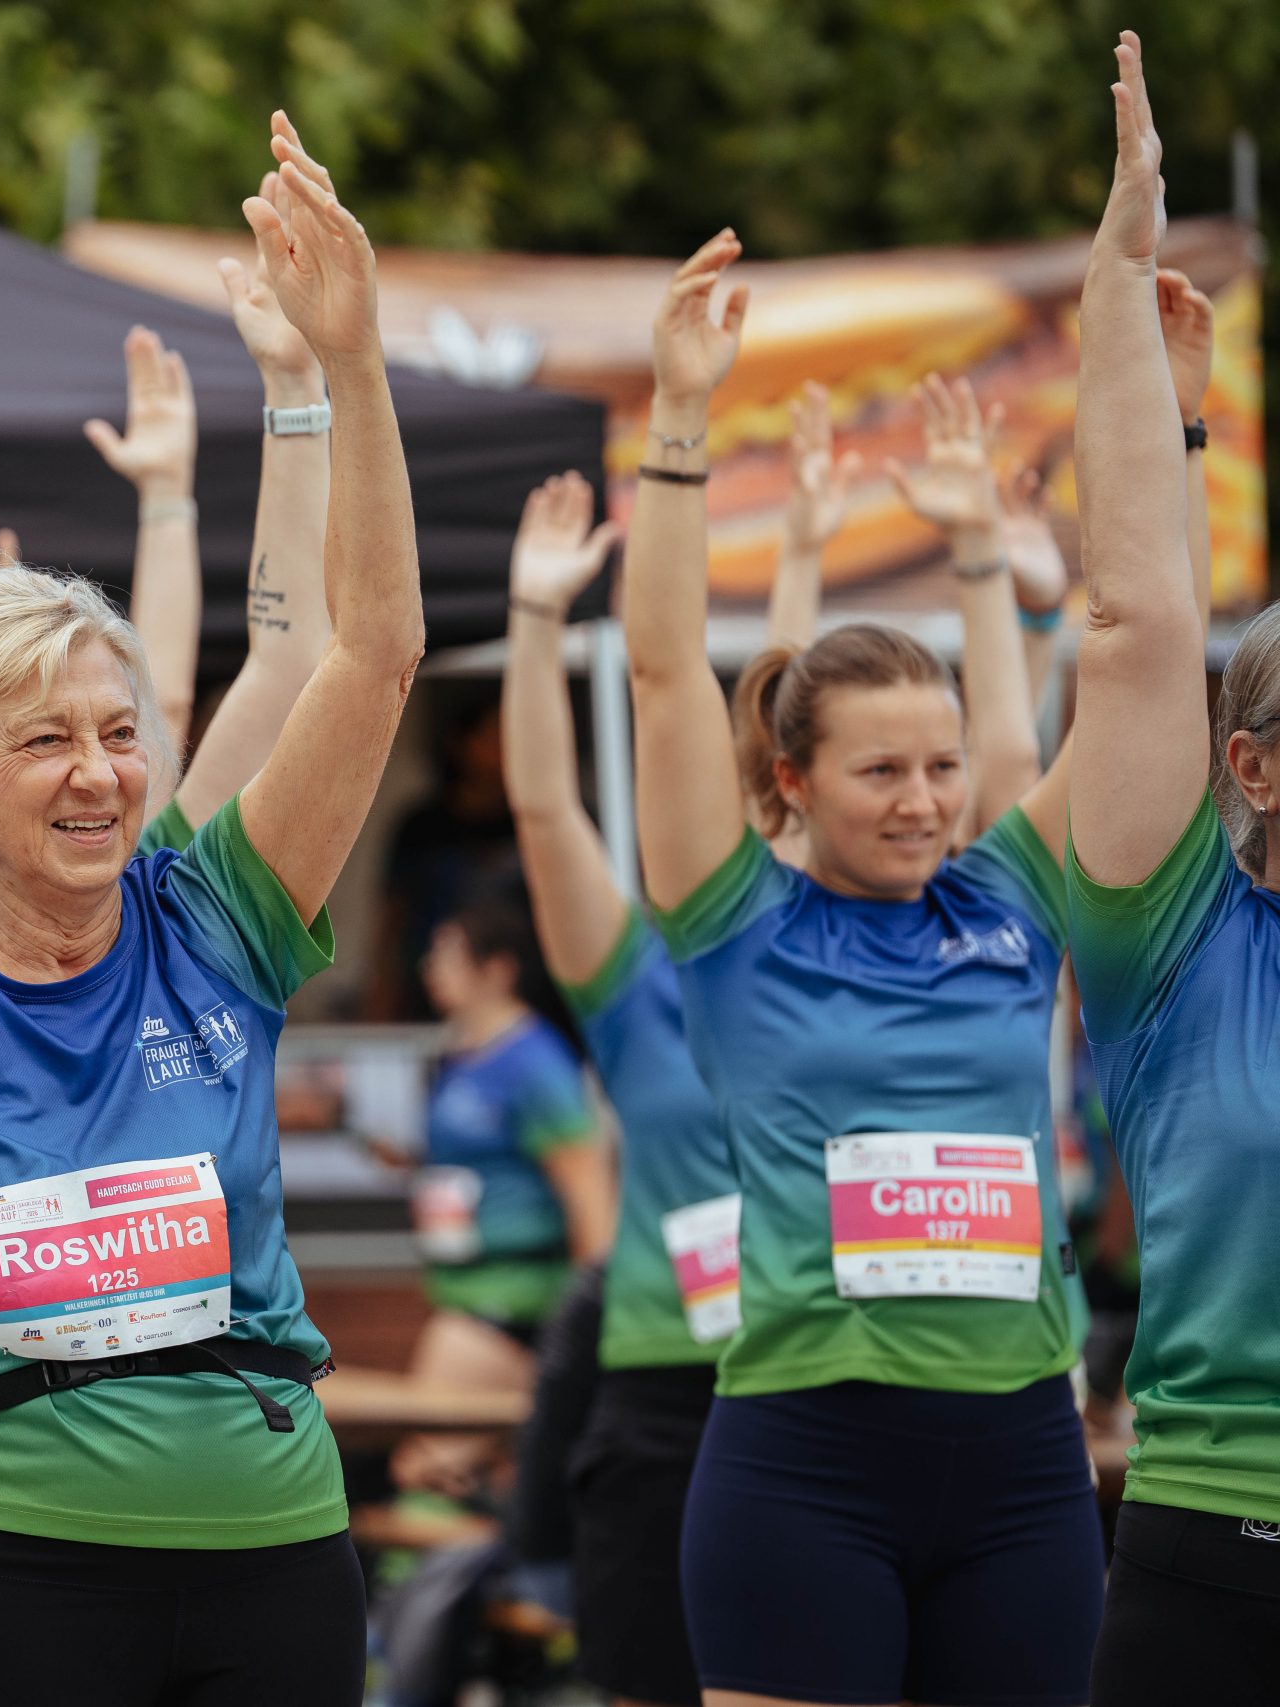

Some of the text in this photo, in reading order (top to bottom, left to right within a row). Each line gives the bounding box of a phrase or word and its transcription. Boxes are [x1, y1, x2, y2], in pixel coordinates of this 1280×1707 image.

[143, 1015, 164, 1032] dm
[144, 1040, 189, 1063] FRAUEN
[148, 1057, 192, 1085] LAUF
[97, 1174, 193, 1199] HAUPTSACH GUDD GELAAF
[870, 1178, 1012, 1217] Carolin
[925, 1220, 970, 1240] 1377
[87, 1267, 139, 1293] 1225
[109, 1291, 138, 1304] STARTZEIT
[153, 1287, 166, 1297] UHR
[140, 1312, 167, 1321] Kaufland
[23, 1327, 41, 1337] dm
